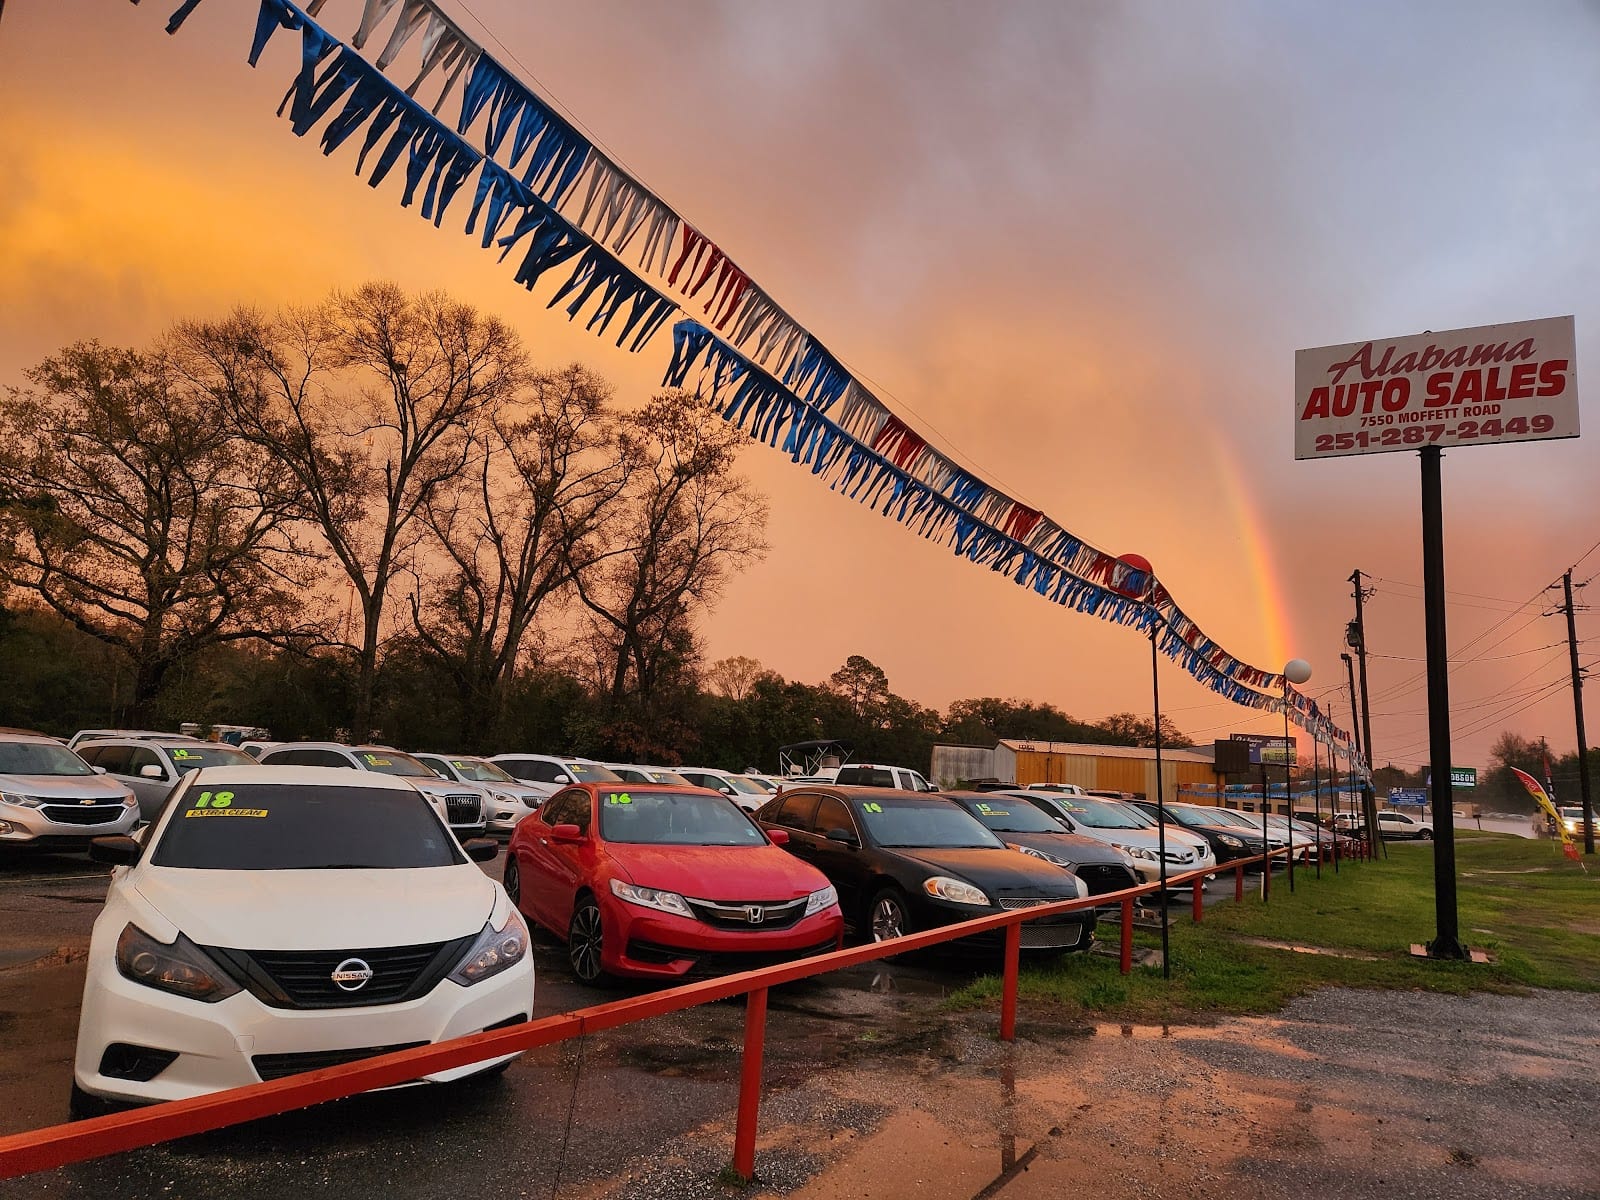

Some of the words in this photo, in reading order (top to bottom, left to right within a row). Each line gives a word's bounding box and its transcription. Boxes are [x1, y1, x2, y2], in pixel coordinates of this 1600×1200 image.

[1327, 338, 1537, 385] Alabama
[1300, 377, 1411, 420] AUTO
[1423, 360, 1569, 407] SALES
[1360, 414, 1394, 427] 7550
[1398, 407, 1459, 424] MOFFETT
[1463, 404, 1501, 418] ROAD
[1315, 415, 1555, 452] 251-287-2449
[195, 791, 236, 808] 18
[610, 793, 632, 804] 16
[976, 803, 992, 812] 15
[191, 809, 226, 817] EXTRA
[227, 809, 262, 817] CLEAN
